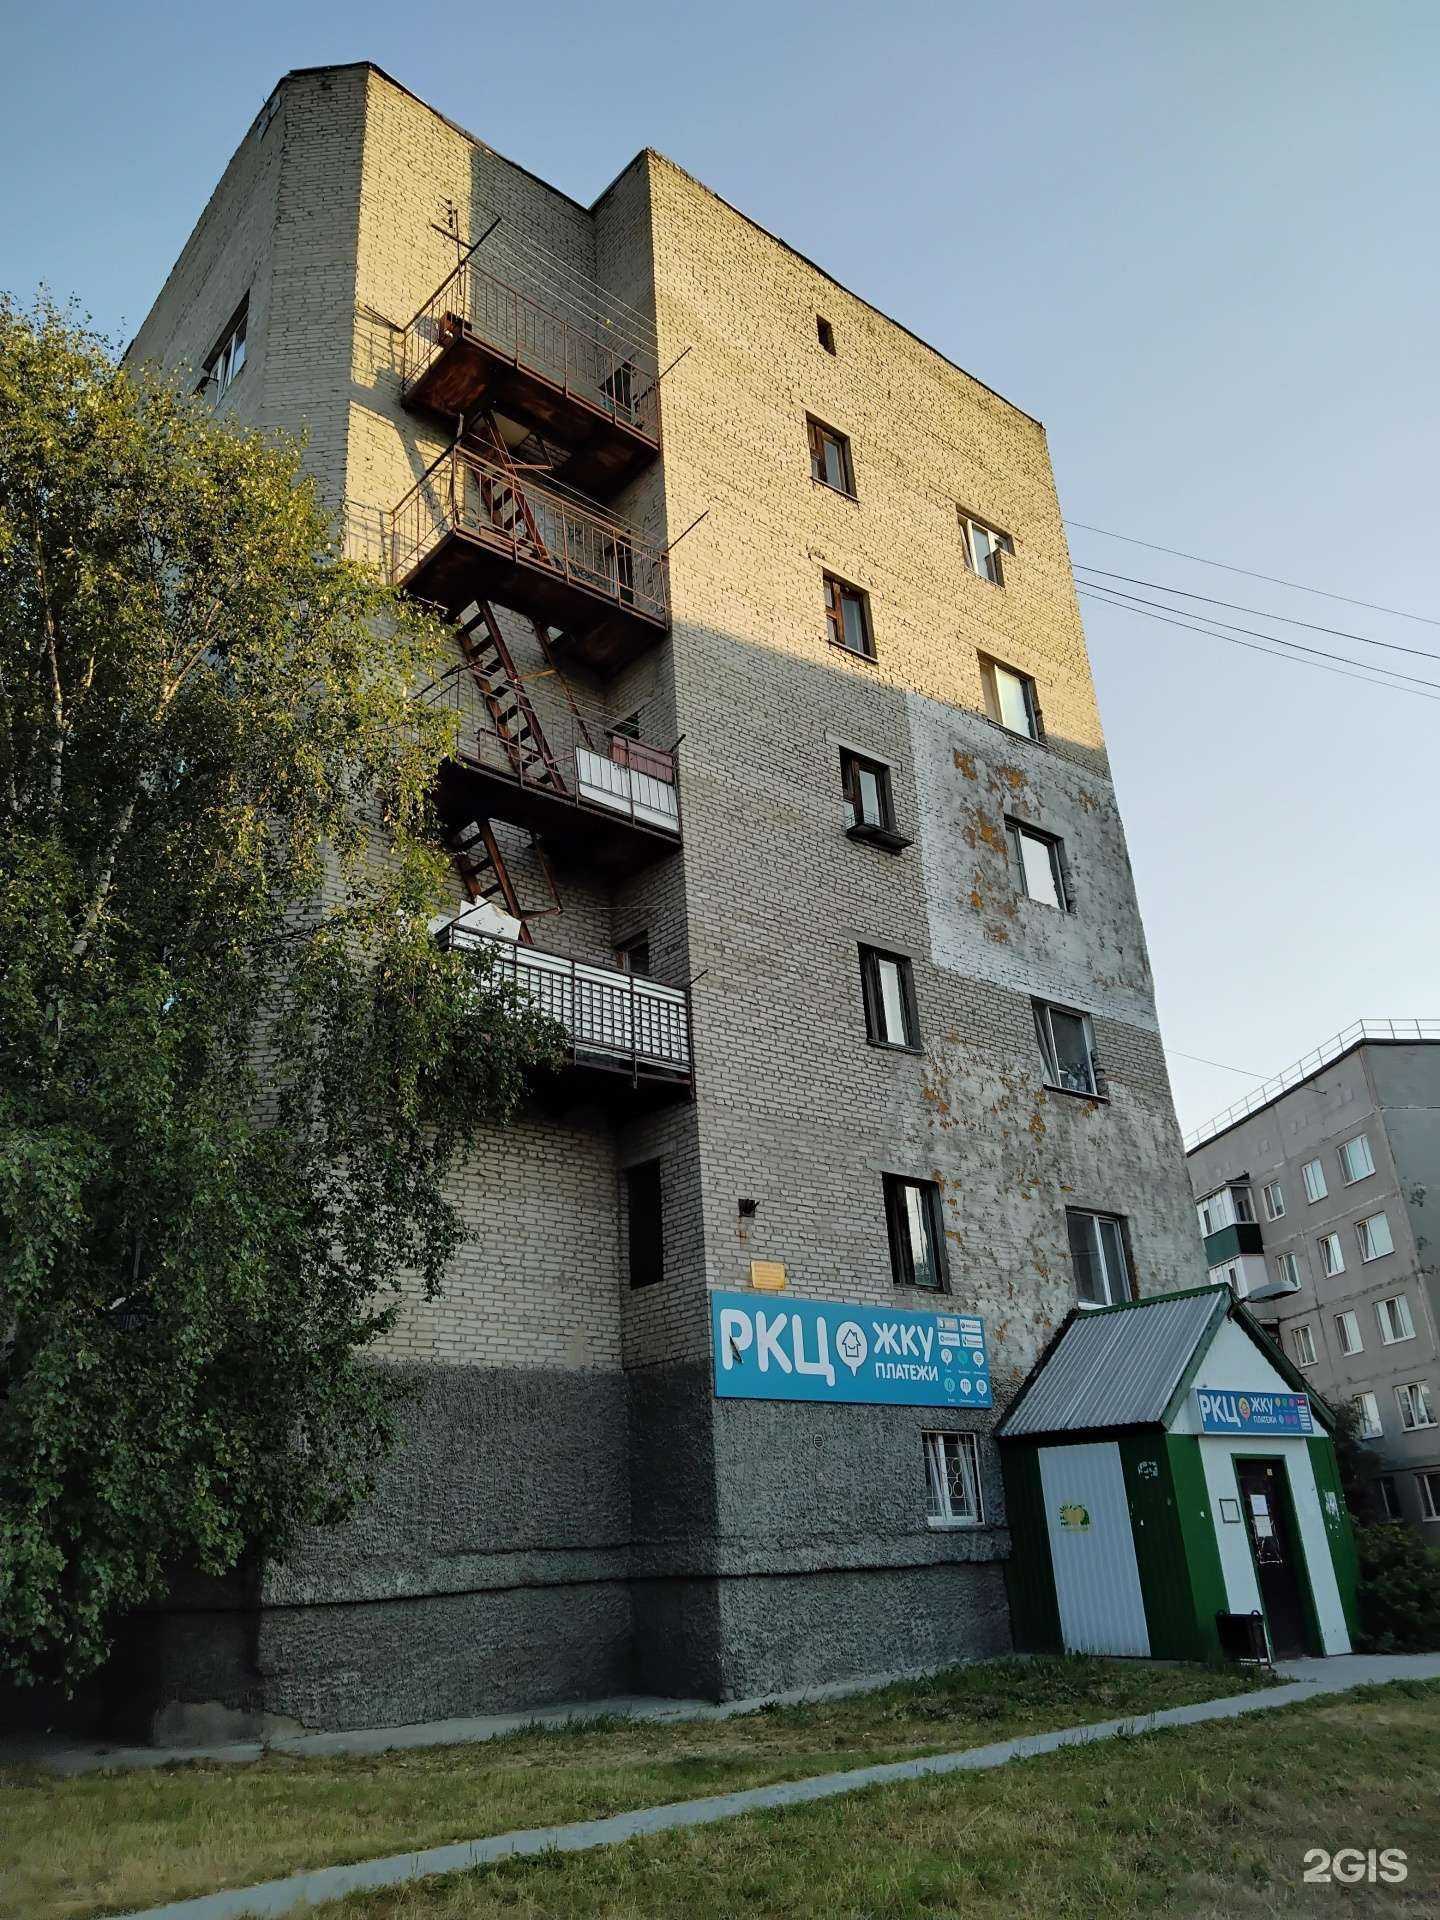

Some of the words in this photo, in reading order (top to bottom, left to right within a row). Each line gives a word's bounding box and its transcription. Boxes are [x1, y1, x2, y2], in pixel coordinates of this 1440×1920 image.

[720, 1308, 836, 1387] РКЦ
[872, 1321, 934, 1363] ЖКУ
[875, 1362, 939, 1382] ПЛАТЕЖИ
[1200, 1394, 1242, 1428] РКЦ
[1251, 1397, 1273, 1415] ЖКУ
